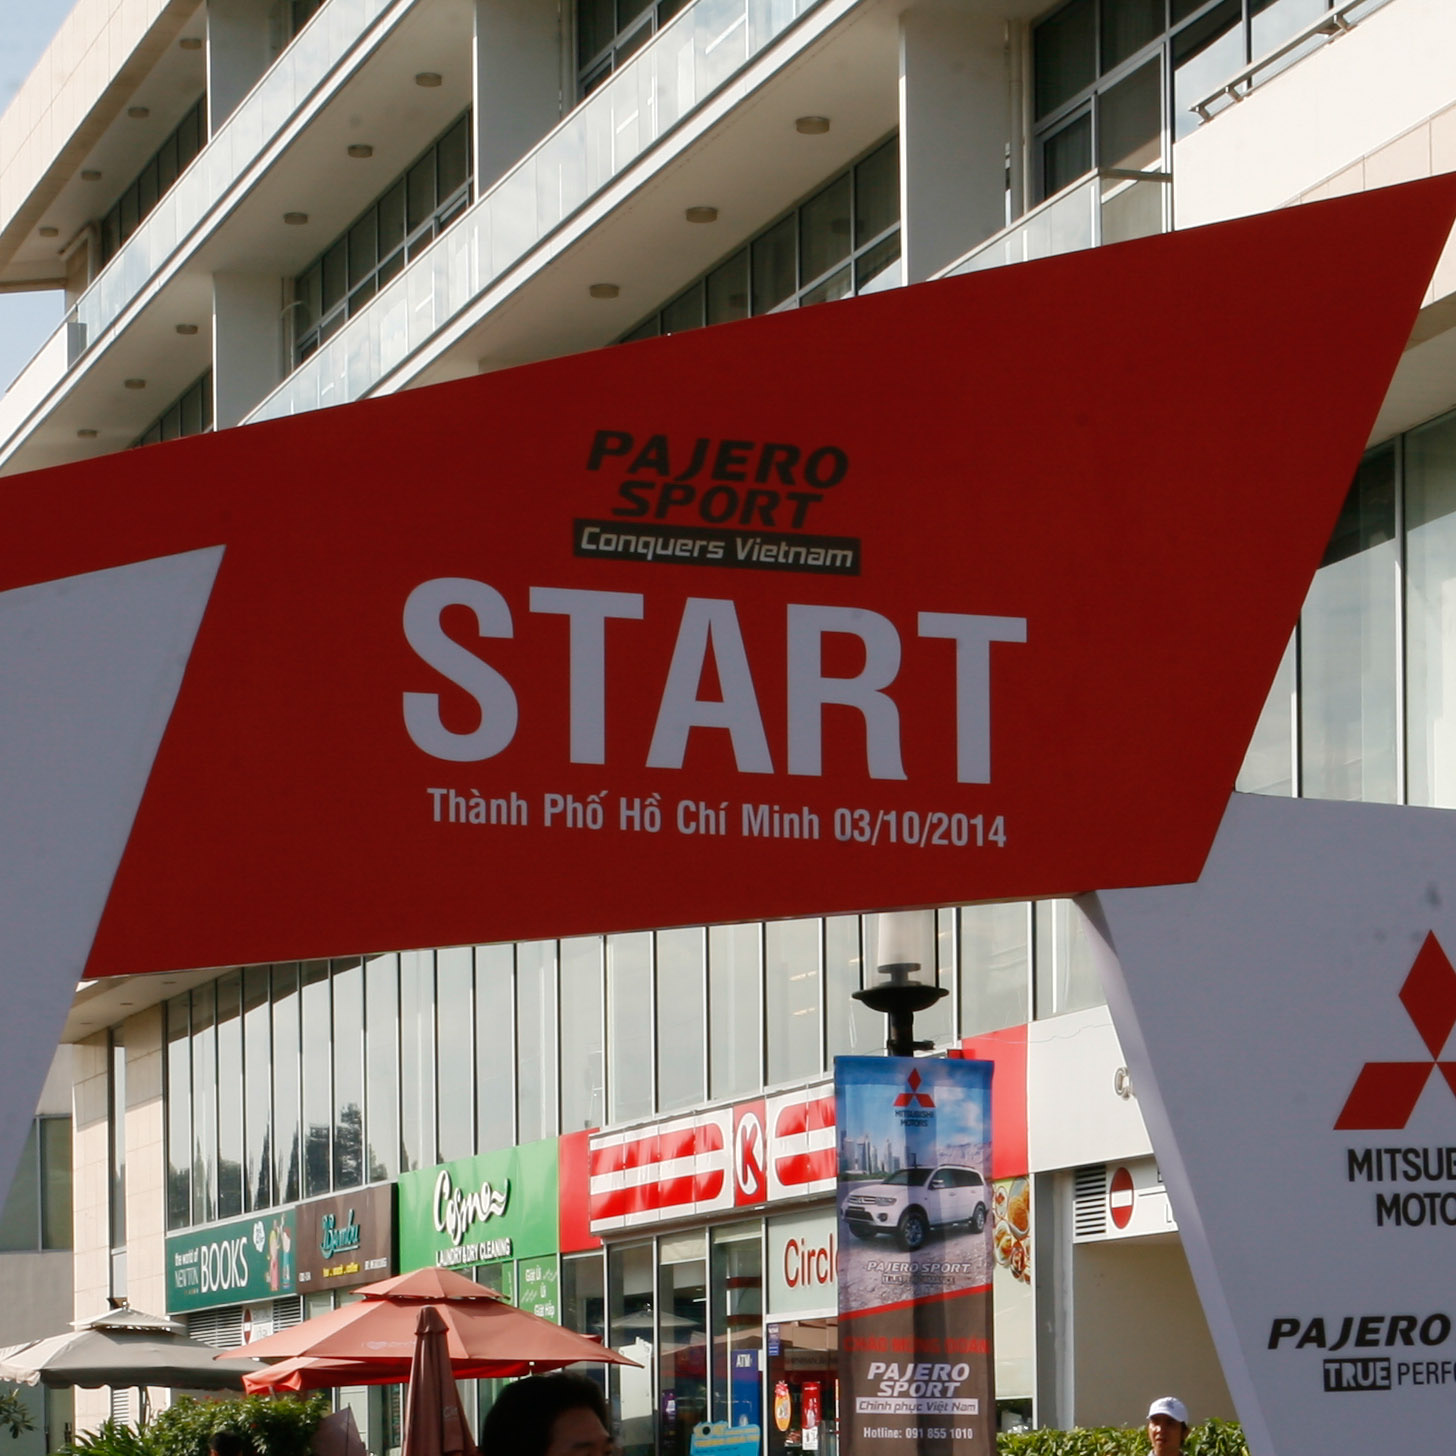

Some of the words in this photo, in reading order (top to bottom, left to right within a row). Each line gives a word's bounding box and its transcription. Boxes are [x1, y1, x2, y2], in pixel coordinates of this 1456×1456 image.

[586, 430, 849, 489] PAJERO
[611, 480, 824, 529] SPORT
[581, 527, 726, 561] Conquers
[736, 537, 853, 568] Vietnam
[402, 577, 1027, 785] START
[426, 788, 528, 826] Thành
[544, 790, 608, 830] Phố
[619, 792, 662, 833] Hồ
[676, 801, 729, 835] Chí
[742, 803, 820, 840] Minh
[834, 808, 1007, 848] 03/10/2014
[739, 1117, 761, 1192] K
[201, 1237, 248, 1293] BOOKS
[784, 1234, 838, 1289] Circl
[866, 1261, 918, 1273] PAJERO
[920, 1263, 971, 1273] SPORT
[1267, 1313, 1451, 1352] PAJERO
[867, 1362, 971, 1382] PAJERO
[877, 1381, 961, 1397] SPORT
[1324, 1359, 1391, 1391] TRUE
[858, 1400, 892, 1410] Chinh
[894, 1401, 923, 1413] phục
[926, 1401, 948, 1413] Việt
[951, 1402, 976, 1412] Nam
[863, 1427, 902, 1439] Hotline:
[905, 1428, 923, 1439] 091
[927, 1428, 946, 1439] 855
[950, 1428, 973, 1439] 1010
